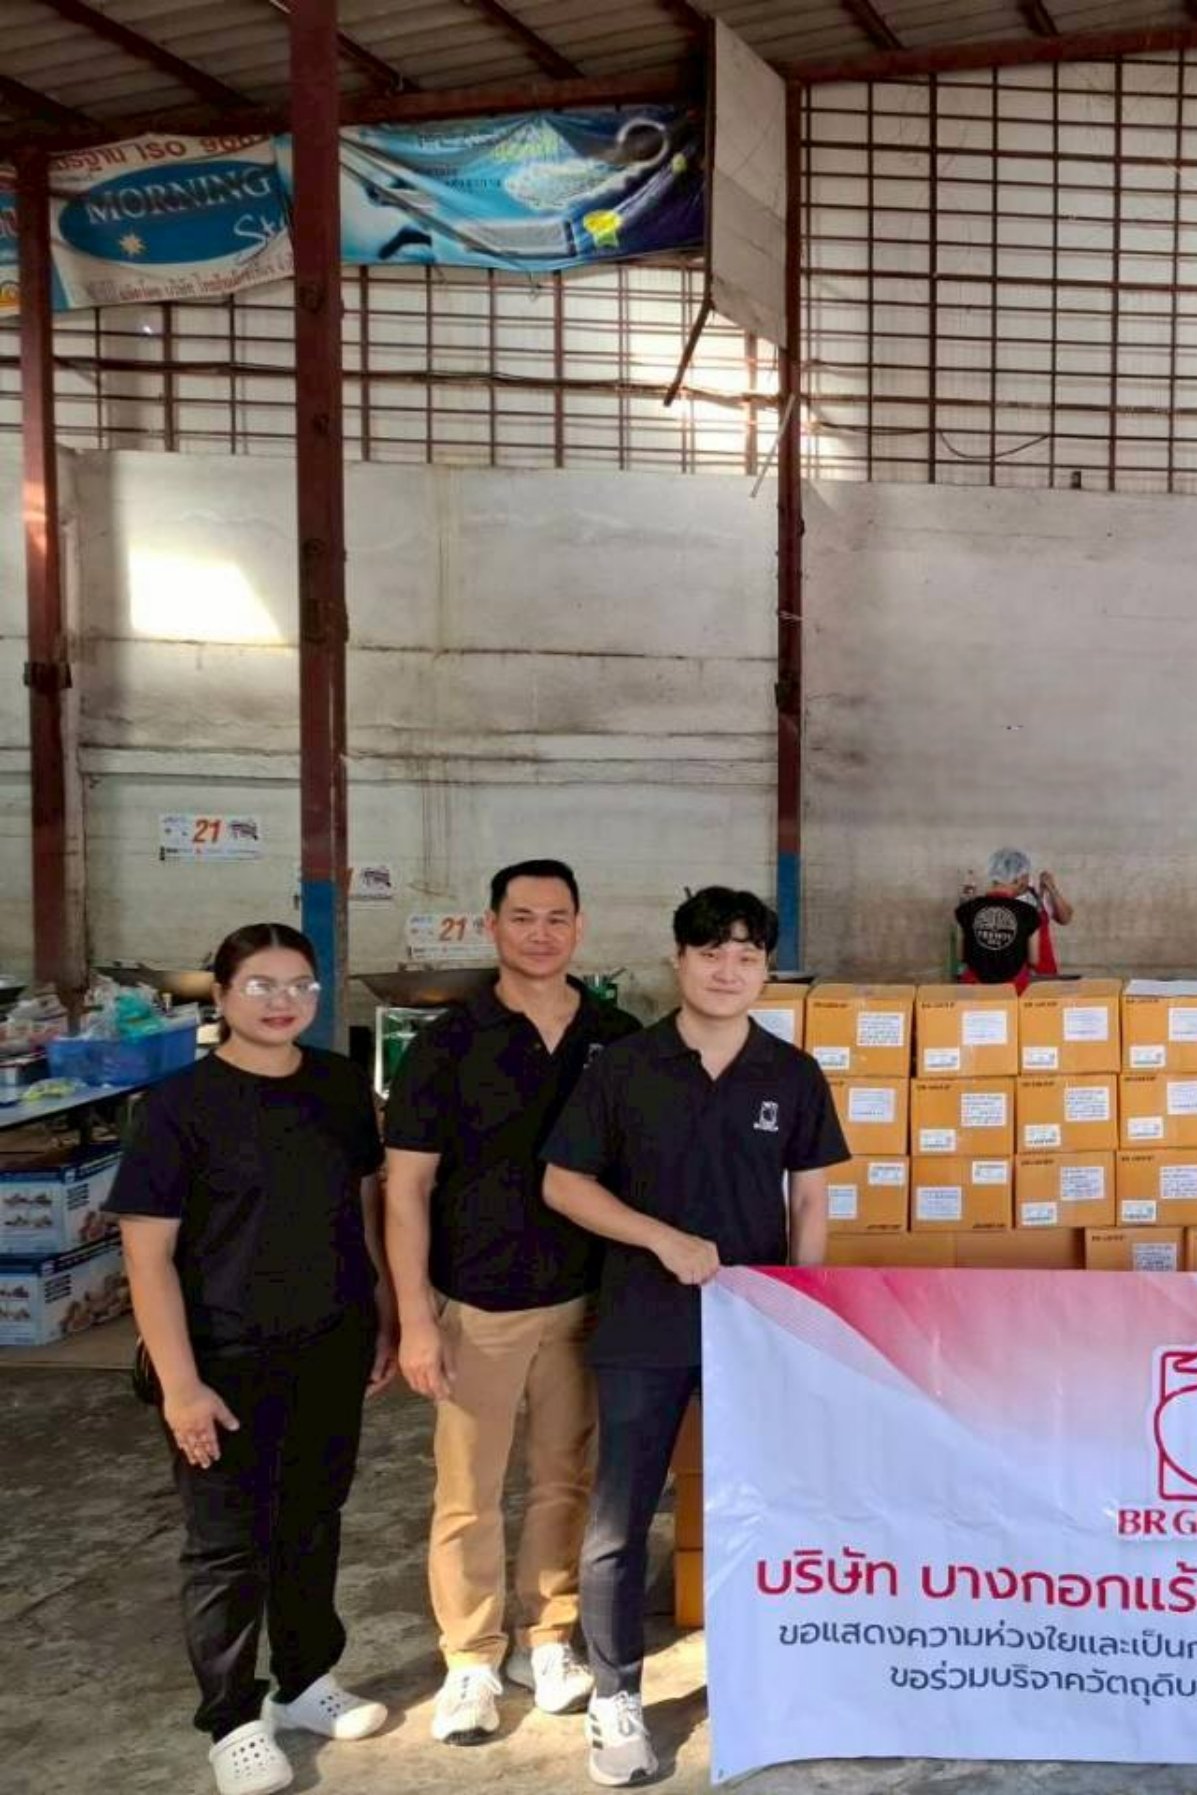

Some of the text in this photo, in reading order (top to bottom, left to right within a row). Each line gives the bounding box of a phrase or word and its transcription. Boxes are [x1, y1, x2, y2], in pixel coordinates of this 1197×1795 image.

[87, 166, 272, 224] MORNING
[192, 818, 223, 844] 21
[438, 915, 468, 942] 21
[1117, 1509, 1167, 1535] BR
[756, 1546, 898, 1597] บริษัท
